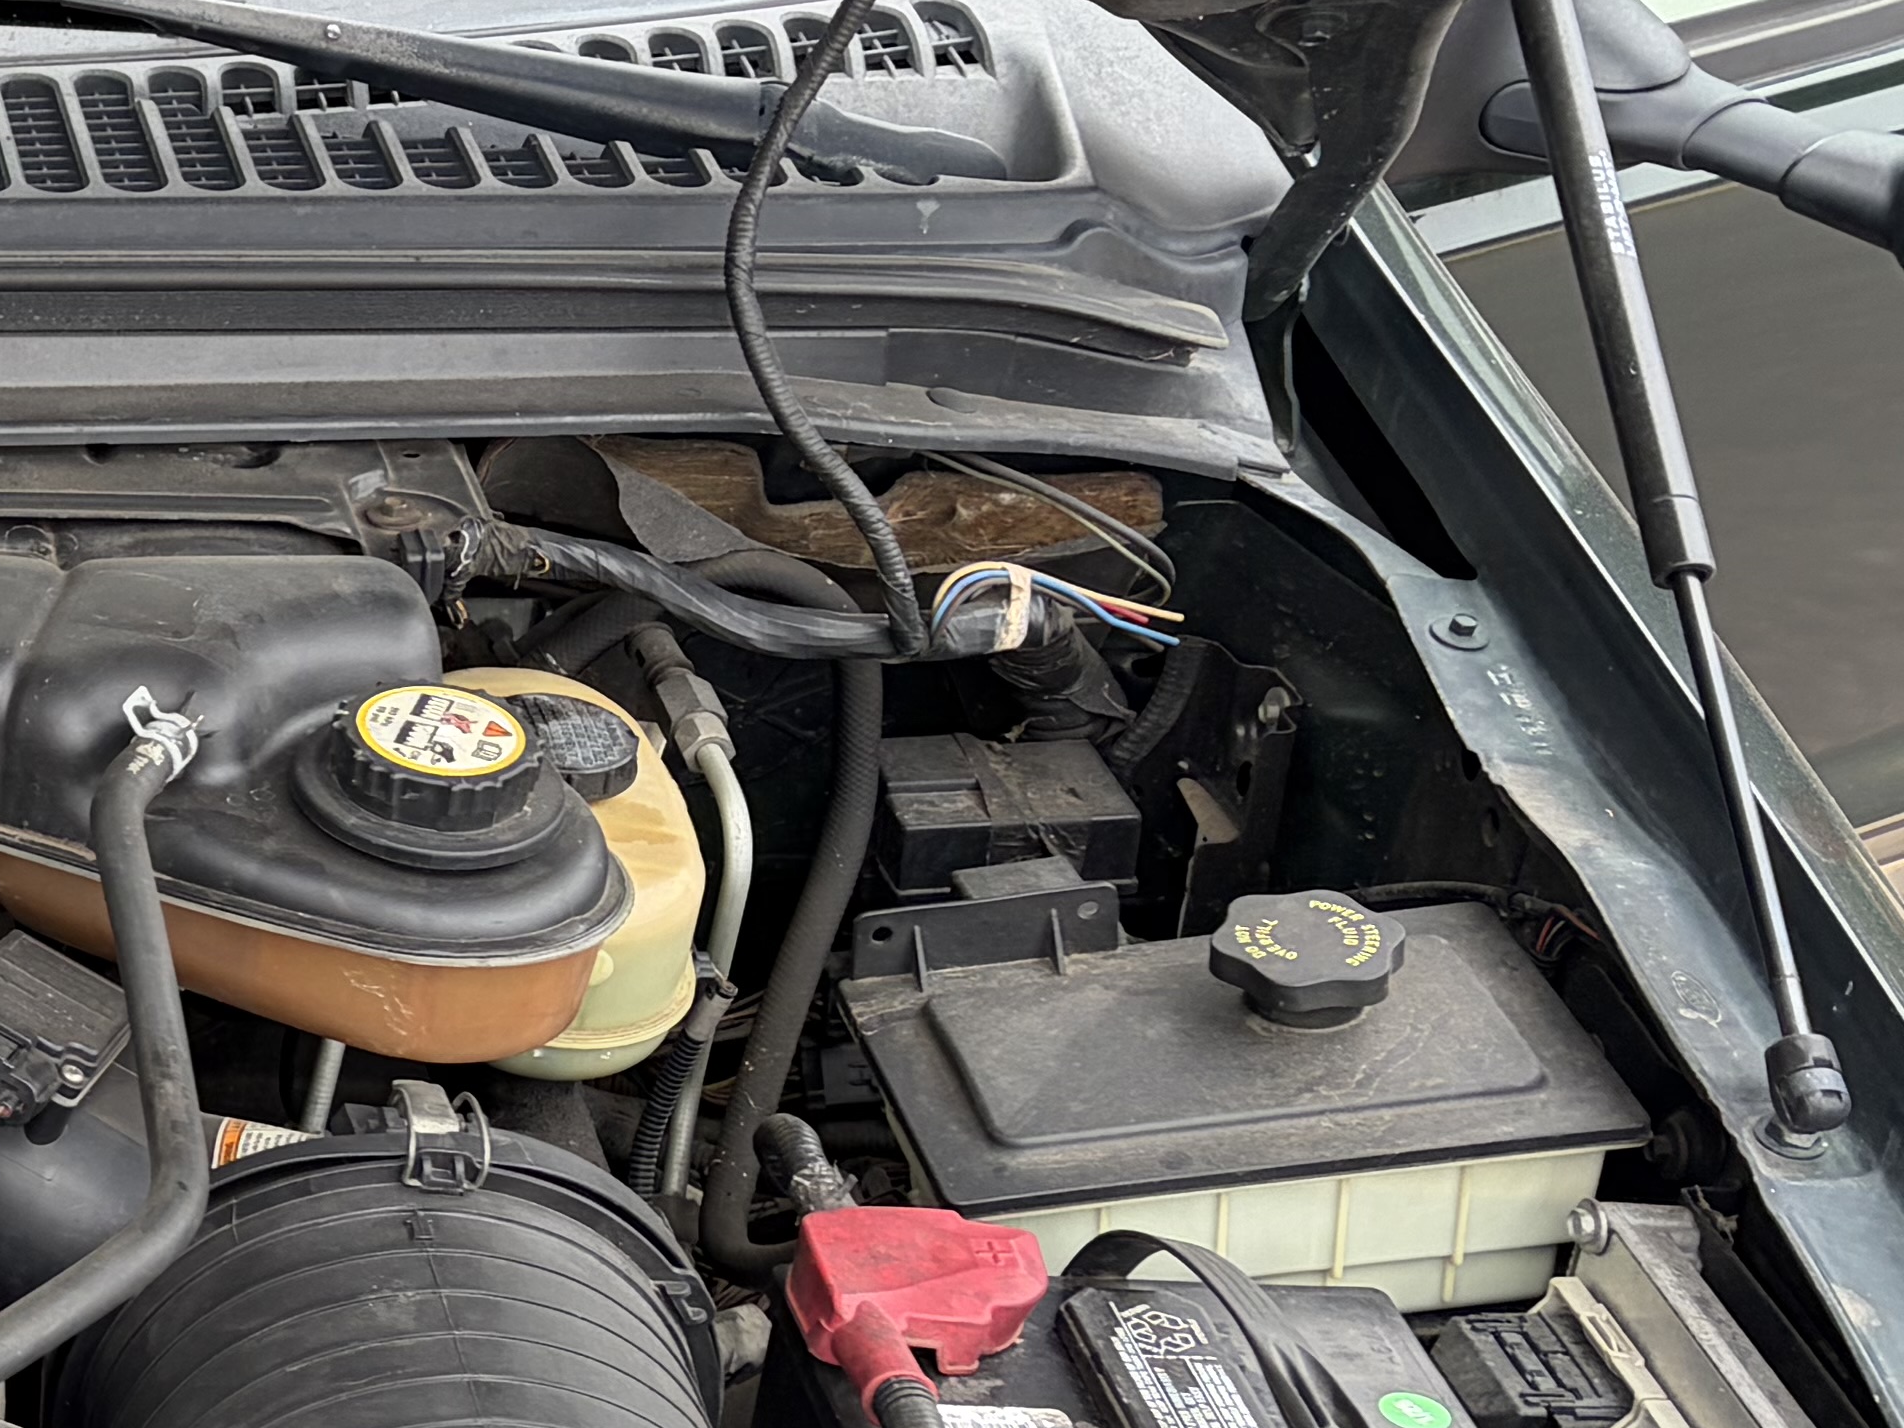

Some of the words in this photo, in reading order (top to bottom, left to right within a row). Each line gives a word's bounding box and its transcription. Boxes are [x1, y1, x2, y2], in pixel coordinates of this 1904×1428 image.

[1308, 899, 1365, 922] POWER
[1254, 918, 1298, 960] OVERFILL
[1327, 916, 1359, 946] FLUID
[1345, 923, 1381, 967] STEERING
